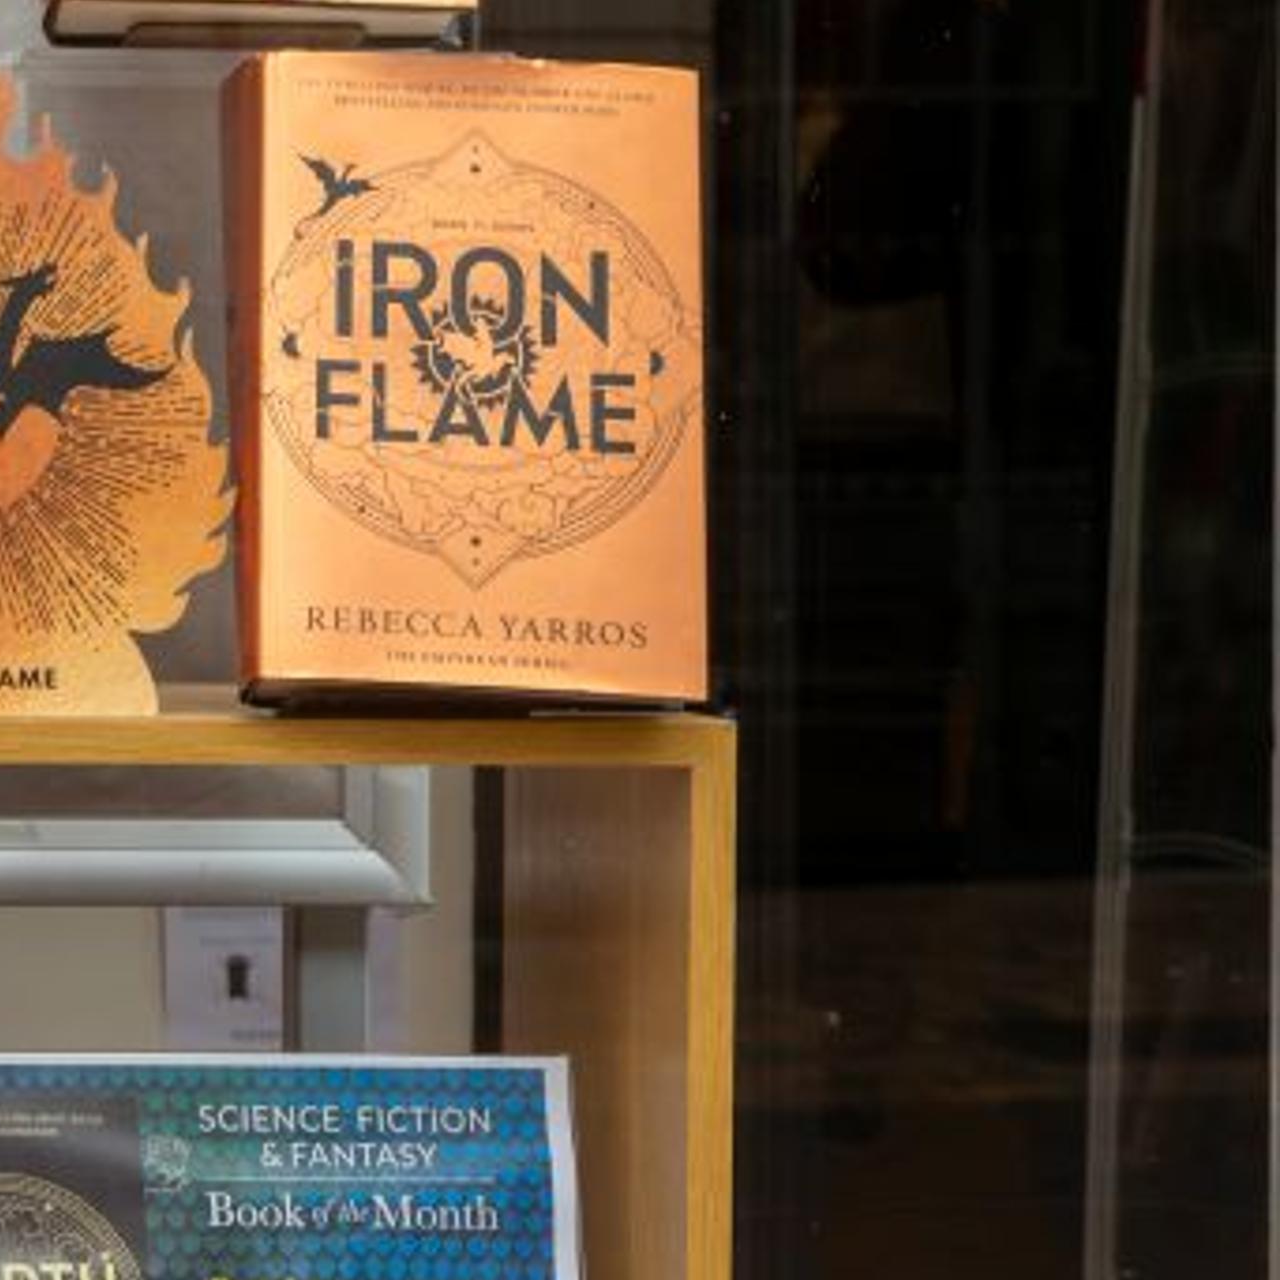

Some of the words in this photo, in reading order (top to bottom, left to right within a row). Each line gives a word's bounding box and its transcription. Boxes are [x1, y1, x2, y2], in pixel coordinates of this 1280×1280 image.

[333, 237, 610, 348] IRON
[315, 358, 637, 455] FLAME
[306, 604, 484, 640] REBECCA
[498, 613, 650, 651] YARROS
[198, 1104, 341, 1134] SCIENCE
[357, 1104, 492, 1134] FICTION
[259, 1142, 283, 1168] &
[292, 1141, 439, 1168] FANTASY
[206, 1190, 306, 1229] Book
[311, 1197, 337, 1230] of
[338, 1196, 371, 1224] the
[373, 1193, 500, 1232] Month
